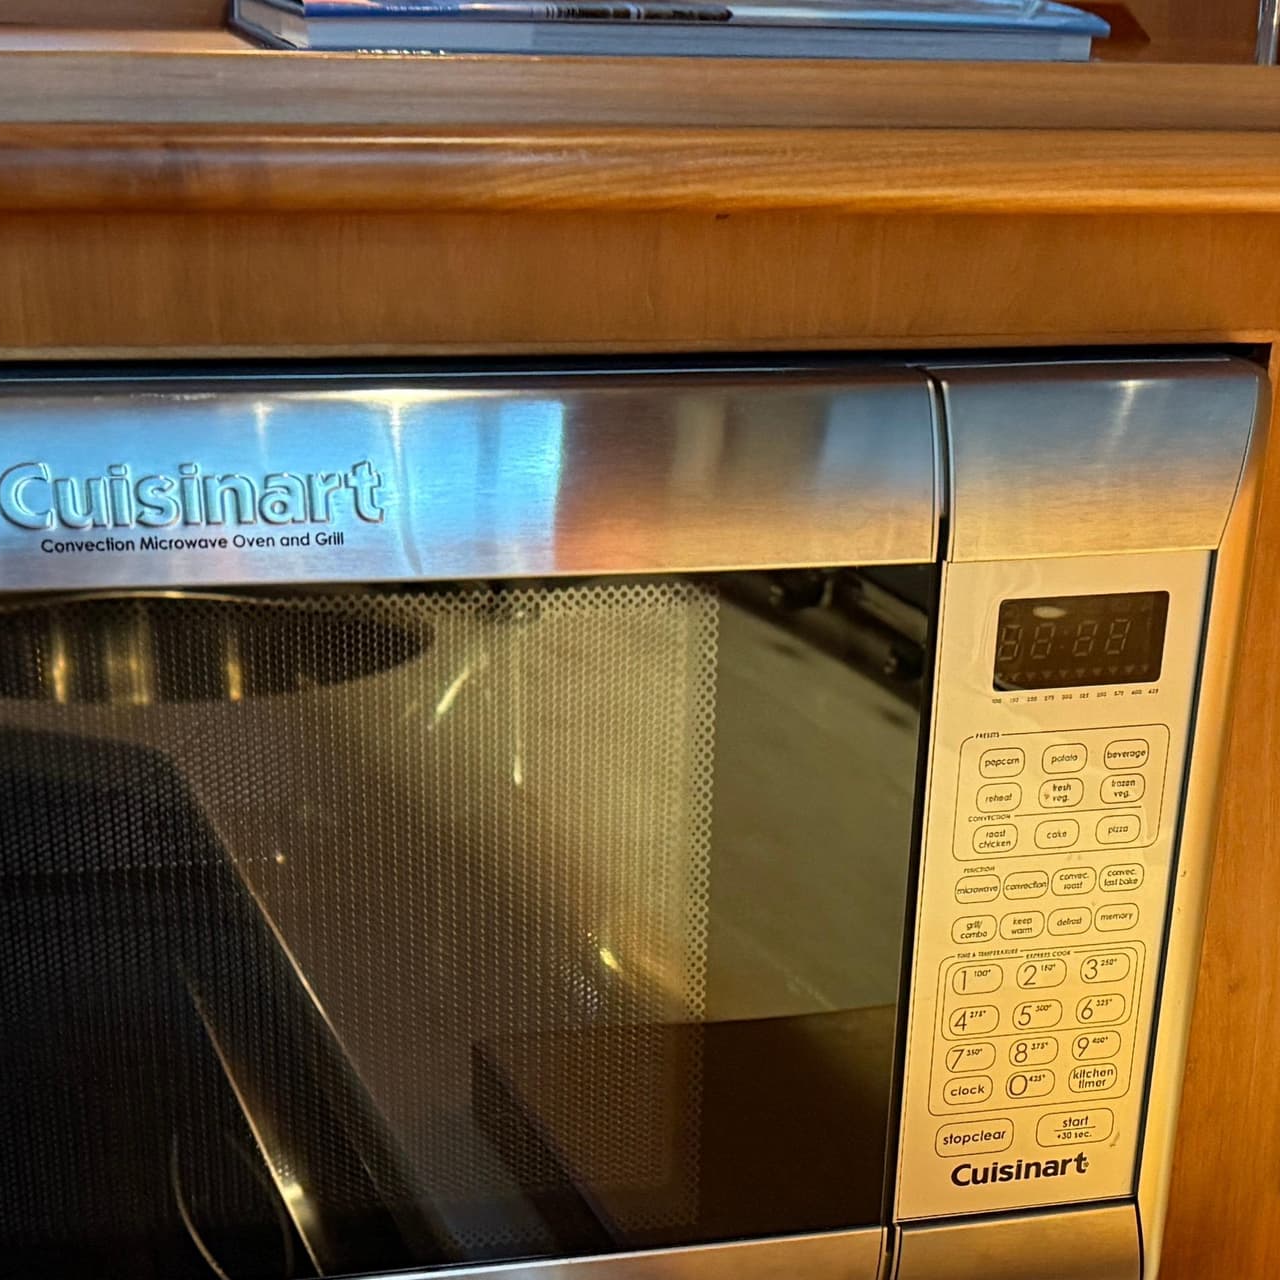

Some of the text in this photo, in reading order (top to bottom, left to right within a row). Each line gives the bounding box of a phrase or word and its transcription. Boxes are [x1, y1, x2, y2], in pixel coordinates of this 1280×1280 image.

[41, 532, 344, 553] Convection Microwave Oven and Grill
[1051, 754, 1078, 764] potato
[1107, 750, 1146, 759] beverage
[985, 758, 1019, 767] popcorn
[1053, 784, 1071, 792] fresh
[985, 794, 1012, 802] reheat
[1047, 830, 1067, 839] cake
[1108, 825, 1128, 834] pizza
[979, 839, 1011, 849] chicken
[1101, 912, 1133, 921] memory
[1084, 959, 1098, 980] 3
[961, 970, 967, 991] 1
[1024, 965, 1037, 986] 2
[1081, 999, 1093, 1020] 6
[954, 1010, 967, 1031] 4
[1018, 1005, 1032, 1026] 5
[1077, 1037, 1089, 1057] 9
[1014, 1043, 1028, 1063] 8
[951, 1049, 965, 1070] 7
[1073, 1068, 1114, 1079] kitchen
[1009, 1075, 1028, 1096] 0
[1078, 1080, 1106, 1089] timer
[950, 1085, 985, 1096] clock
[1063, 1116, 1088, 1128] start
[1074, 1130, 1092, 1138] sec.
[951, 1152, 1088, 1187] Cuisinart
